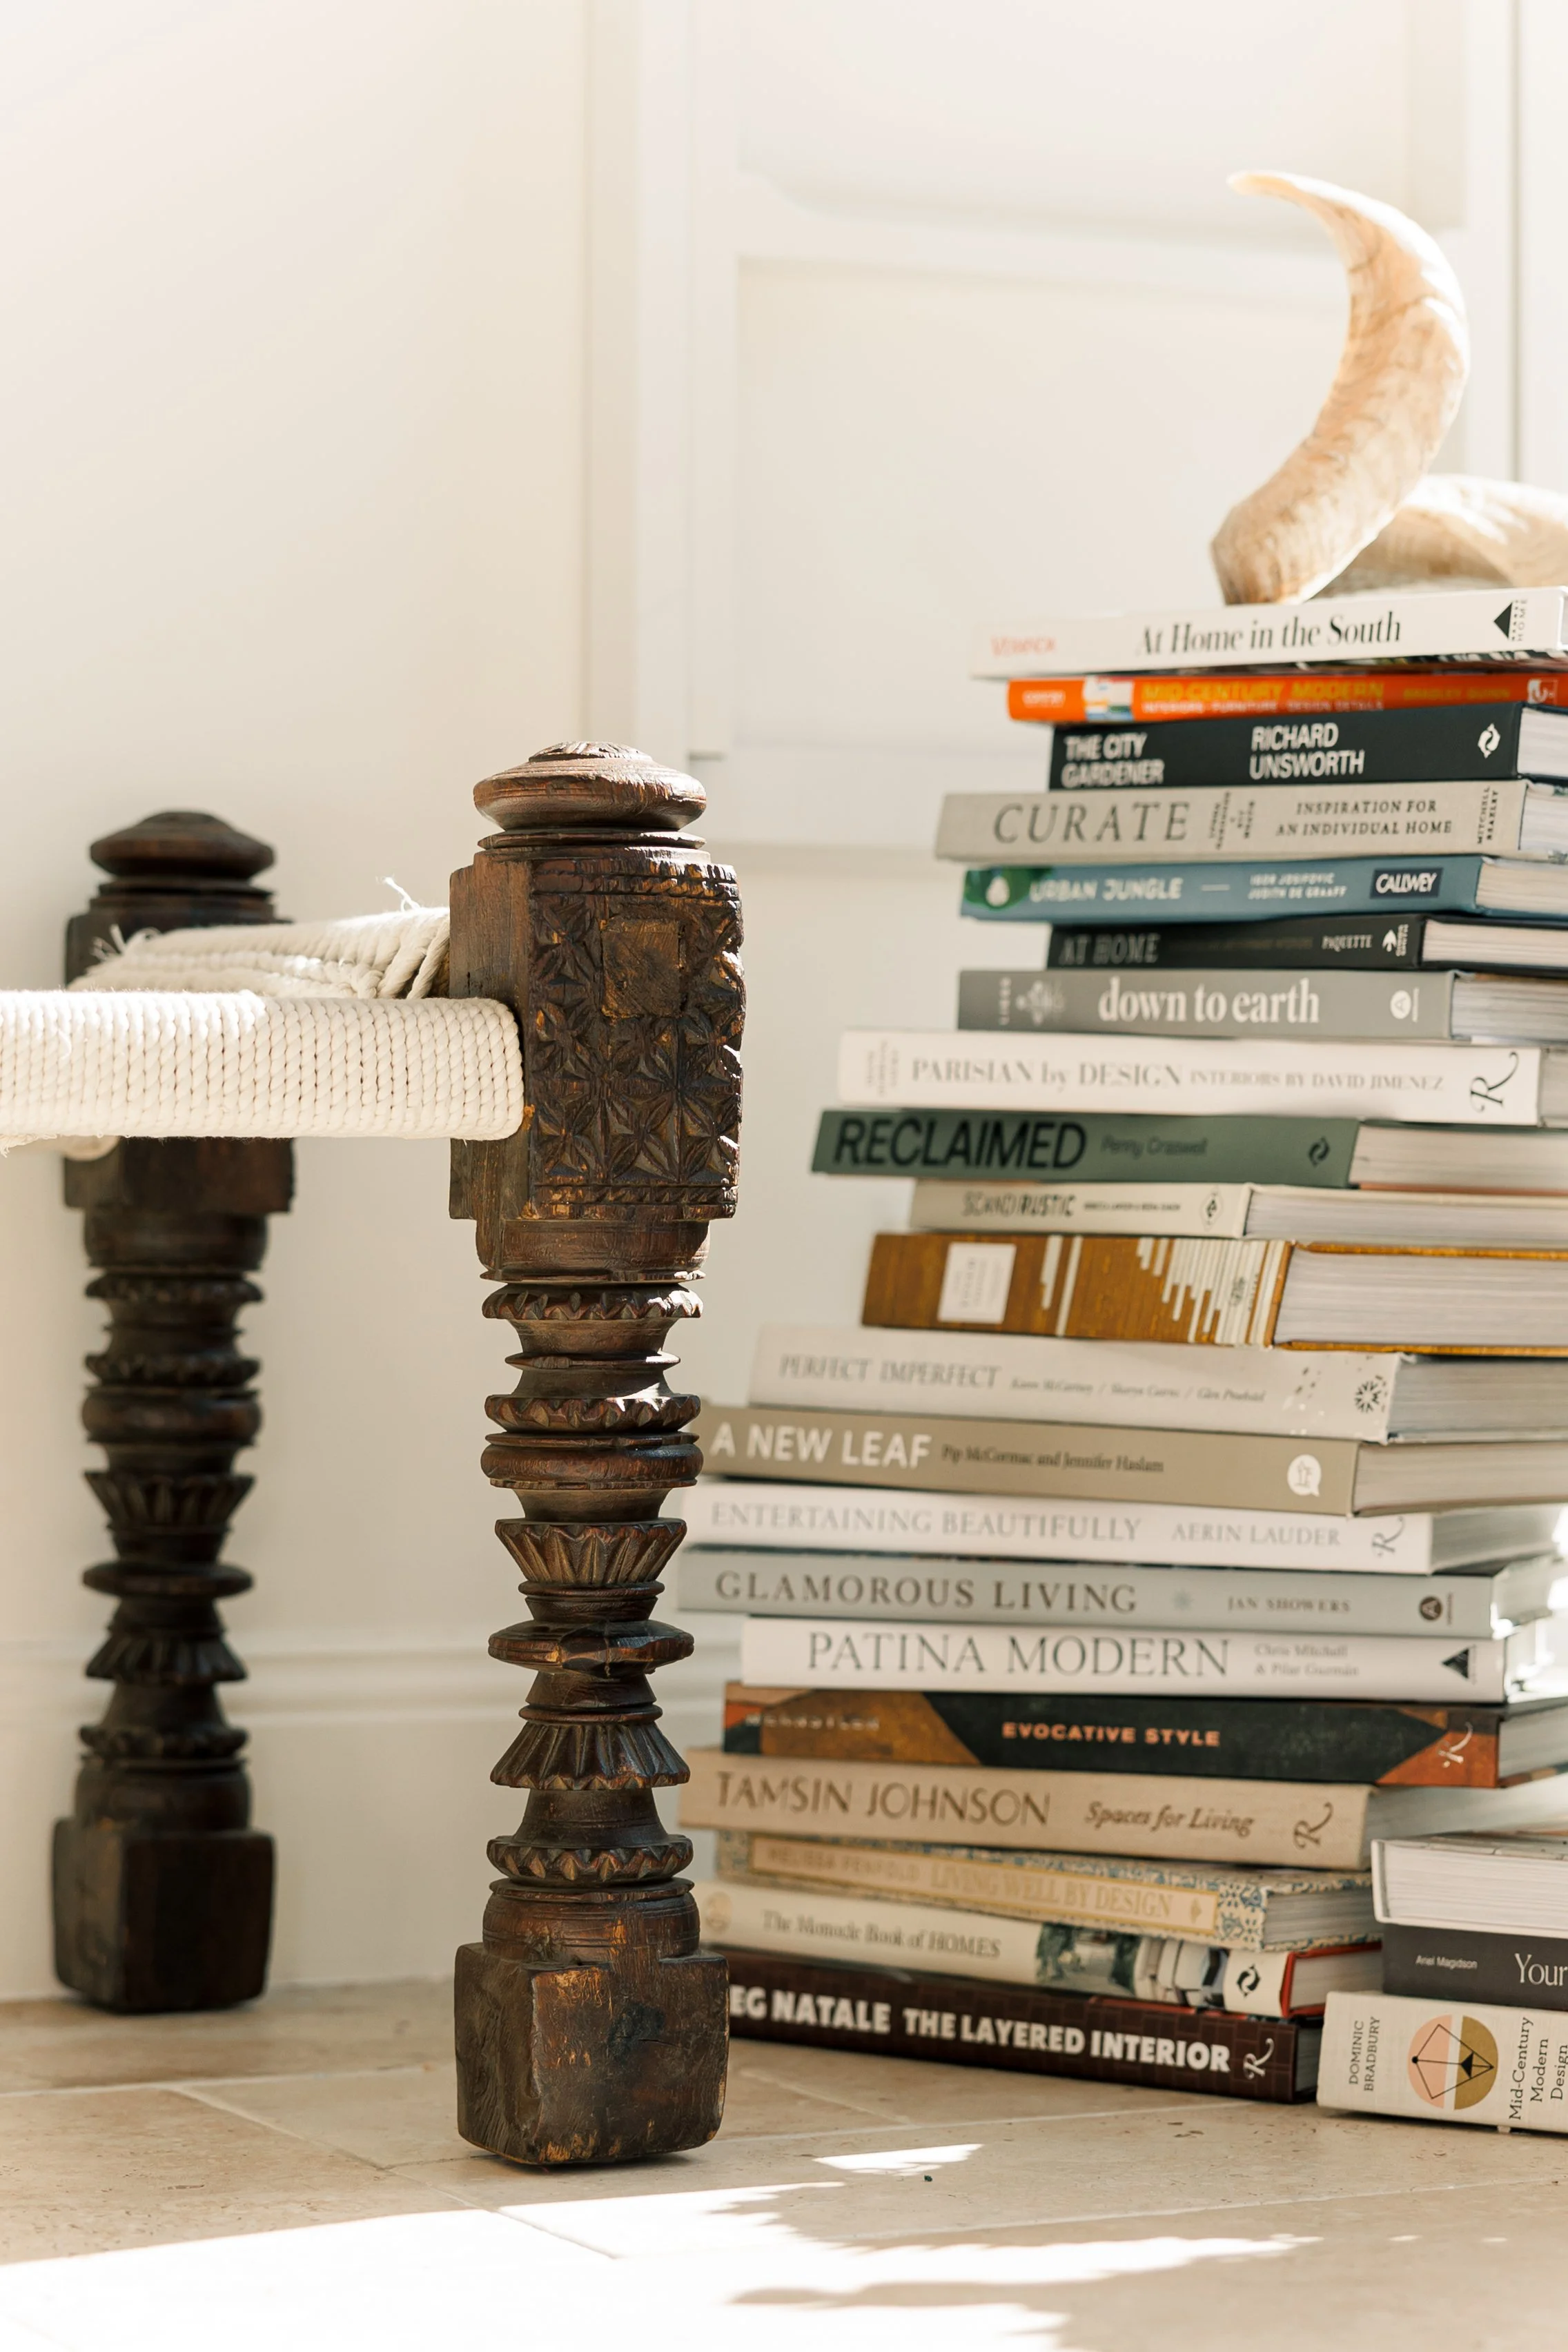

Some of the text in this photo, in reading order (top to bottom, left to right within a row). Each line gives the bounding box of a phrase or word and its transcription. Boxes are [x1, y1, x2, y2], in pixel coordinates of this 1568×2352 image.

[1137, 611, 1401, 655] At Home in the South
[1064, 732, 1148, 760] THE CITY
[1251, 722, 1339, 752] RICHARD
[1061, 759, 1166, 788] GARDENER
[1249, 749, 1365, 780] UNSWORTH
[993, 801, 1190, 844] CURATE
[1296, 800, 1437, 816] INSPIRATION FOR
[1275, 820, 1452, 836] AN INDIVIDUAL HOME
[1029, 878, 1184, 903] URBAN JUNGLE
[1059, 936, 1090, 965] AT
[1093, 933, 1160, 963] HOME
[1098, 977, 1319, 1022] down to earth
[912, 1059, 1032, 1084] PARISIAN
[1041, 1061, 1066, 1091] by
[1078, 1063, 1182, 1087] DESIGN
[1190, 1070, 1444, 1090] INTERIORS BY DAVID JIMENEZ
[832, 1117, 1087, 1169] RECLAIMED
[779, 1353, 1000, 1389] PERFECT IMPERFECT
[710, 1422, 931, 1469] A NEW LEAF
[1038, 1452, 1061, 1466] and
[711, 1501, 1141, 1541] ENTERTAINING BEAUTIFULLY
[1173, 1522, 1340, 1546] AERIN LAUDER
[715, 1570, 1136, 1614] GLAMOROUS LIVING
[1228, 1596, 1350, 1613] JAN SHOWERS
[809, 1631, 1230, 1676] PATINA MODERN
[1002, 1722, 1220, 1747] EVOCATIVE STYLE
[716, 1772, 1050, 1826] TAMSIN JOHNSON
[1086, 1801, 1254, 1837] Spaces for Living
[1064, 1881, 1090, 1908] BY
[1095, 1883, 1174, 1918] DESIGN
[763, 1908, 792, 1930] The
[863, 1923, 903, 1947] Book
[908, 1928, 928, 1948] of
[928, 1930, 1001, 1959] HOMES
[1514, 1953, 1568, 1986] Your
[729, 1984, 892, 2035] EG NATALE
[902, 2007, 1231, 2072] THE LAYERED INTERIOR
[1349, 2020, 1364, 2085] DOMINIC
[1364, 2016, 1381, 2093] BRADBURY
[1509, 2017, 1533, 2120] Mid-Century
[1530, 2038, 1549, 2103] Modern
[1550, 2045, 1568, 2100] Design
